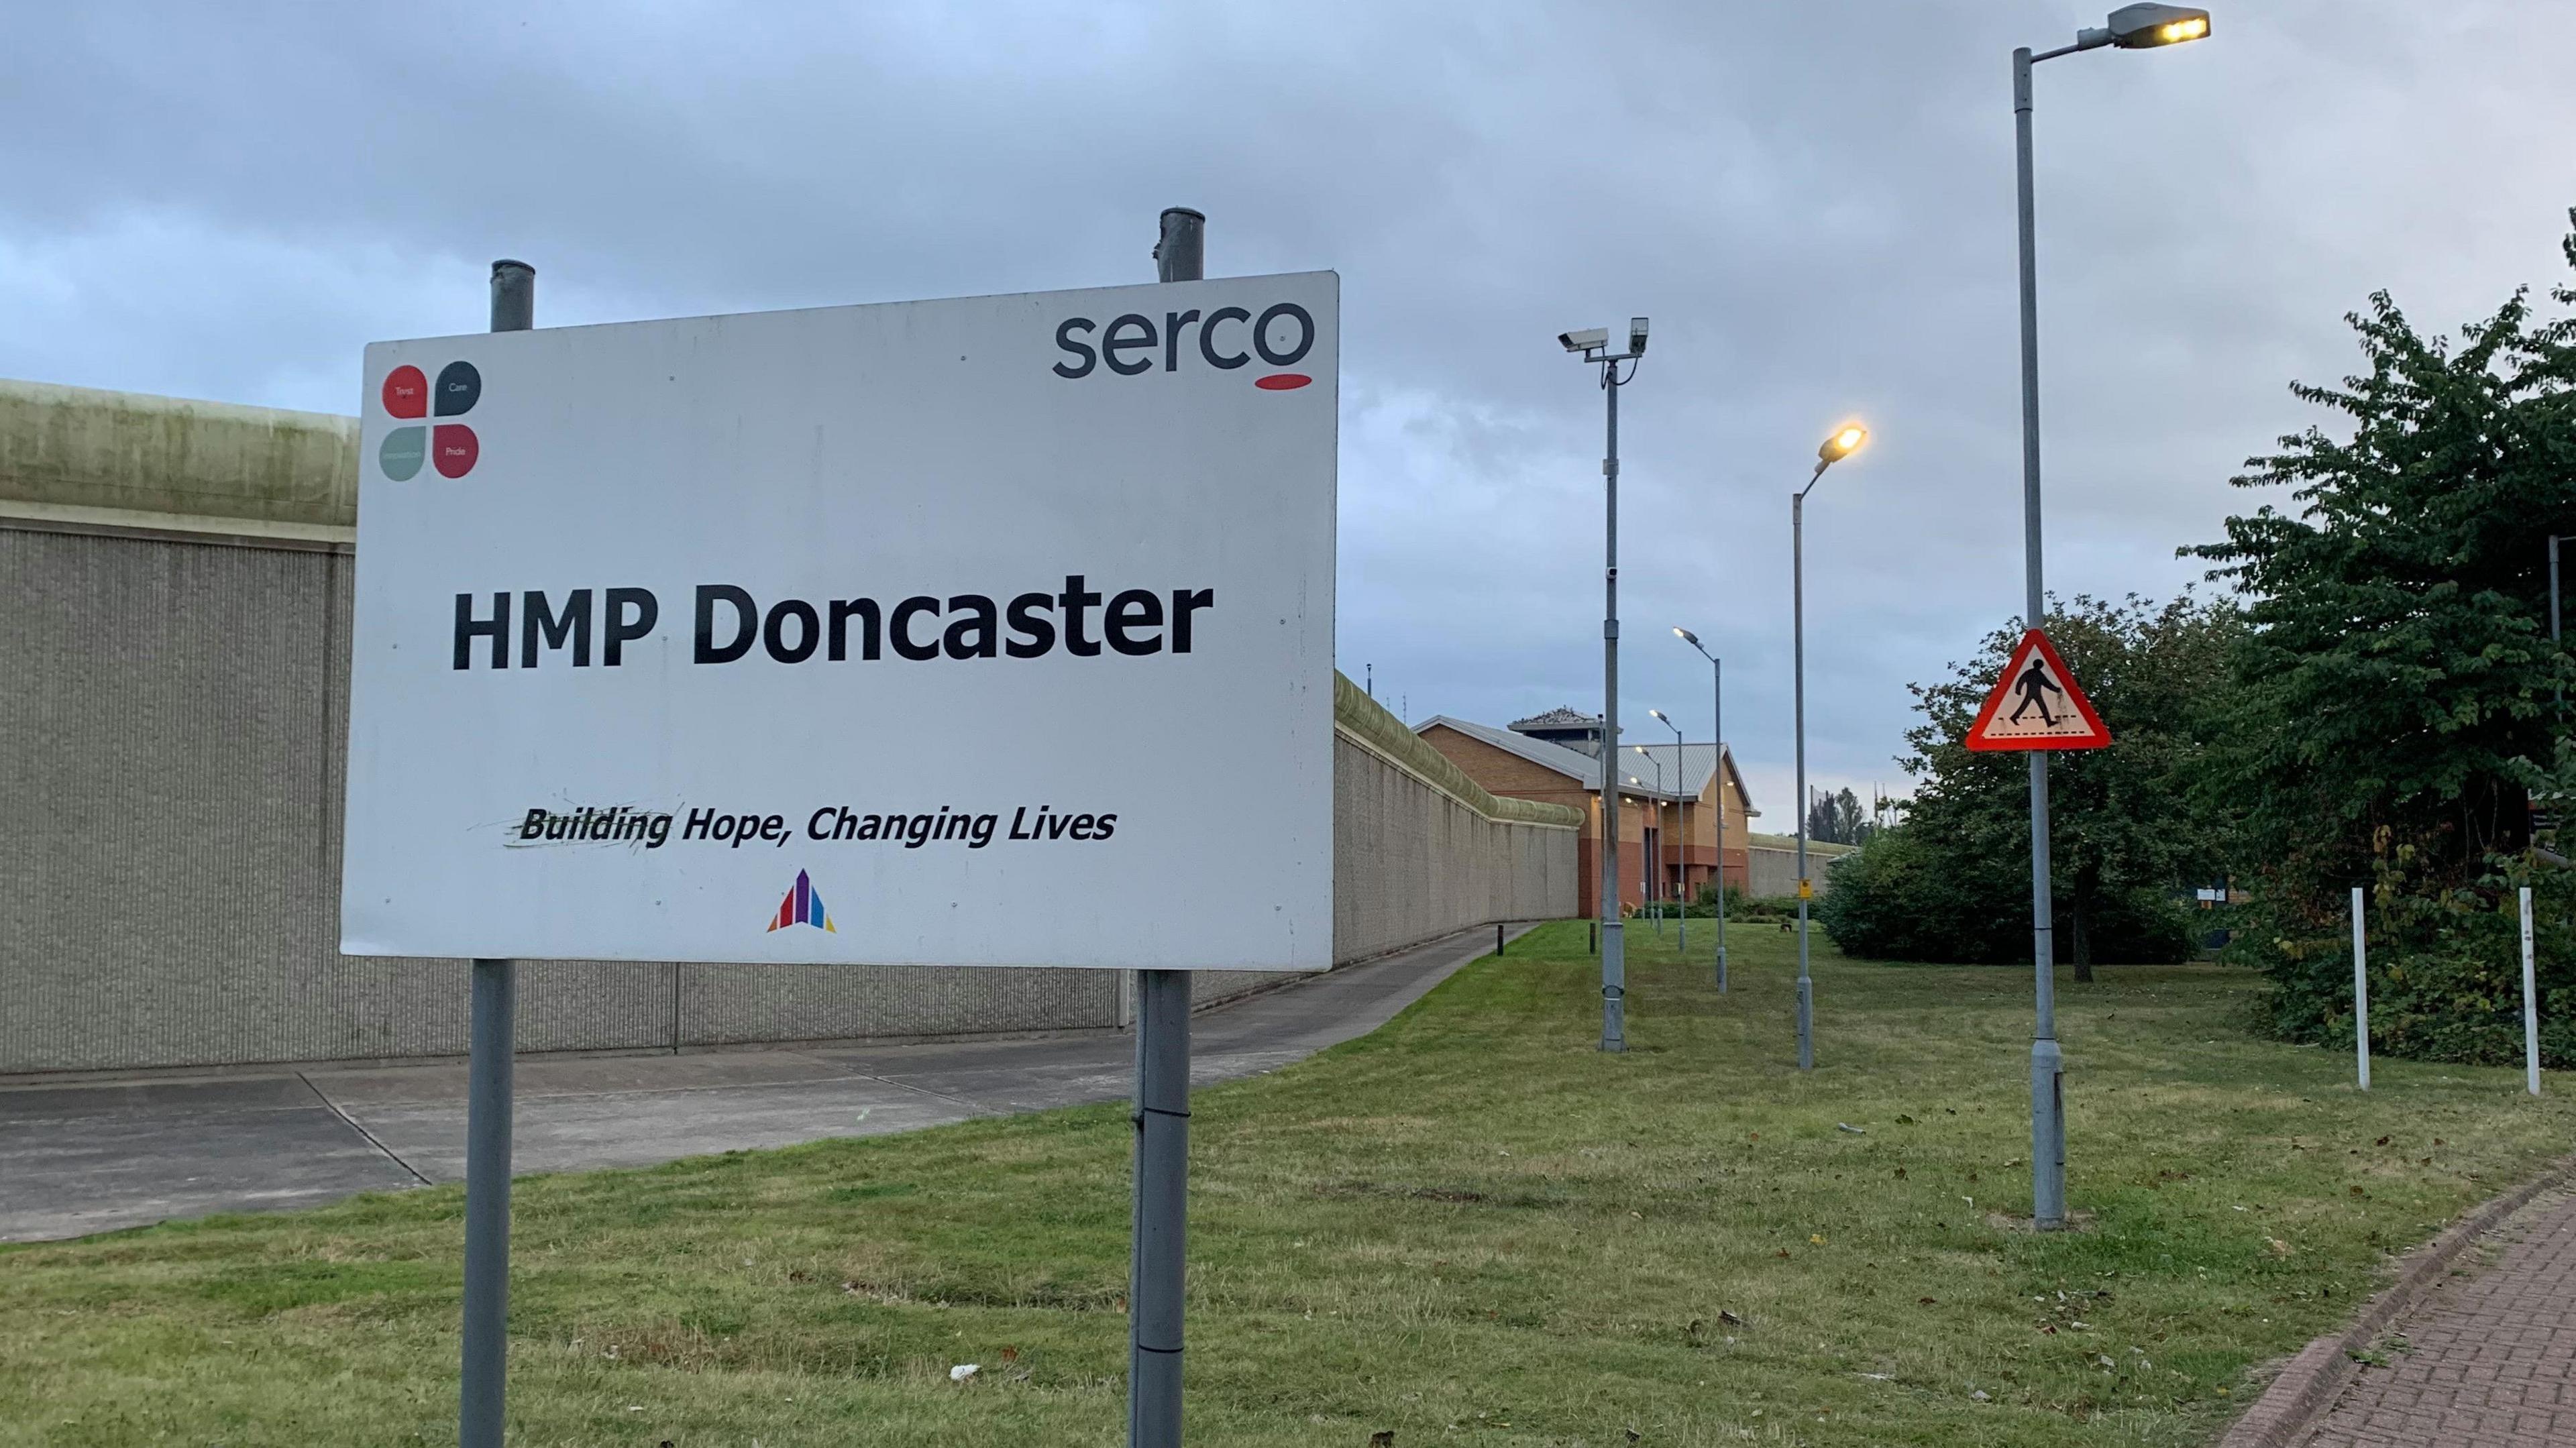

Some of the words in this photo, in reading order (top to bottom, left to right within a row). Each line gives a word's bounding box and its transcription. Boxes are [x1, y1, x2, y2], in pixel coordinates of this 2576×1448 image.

[1053, 303, 1315, 379] serco
[449, 383, 467, 392] Care
[445, 447, 466, 456] Pride
[453, 587, 658, 671] HMP
[694, 575, 1214, 665] Doncaster
[520, 806, 674, 849] Building
[682, 807, 792, 848] Hope,
[808, 805, 998, 849] Changing
[1008, 805, 1118, 840] Lives
